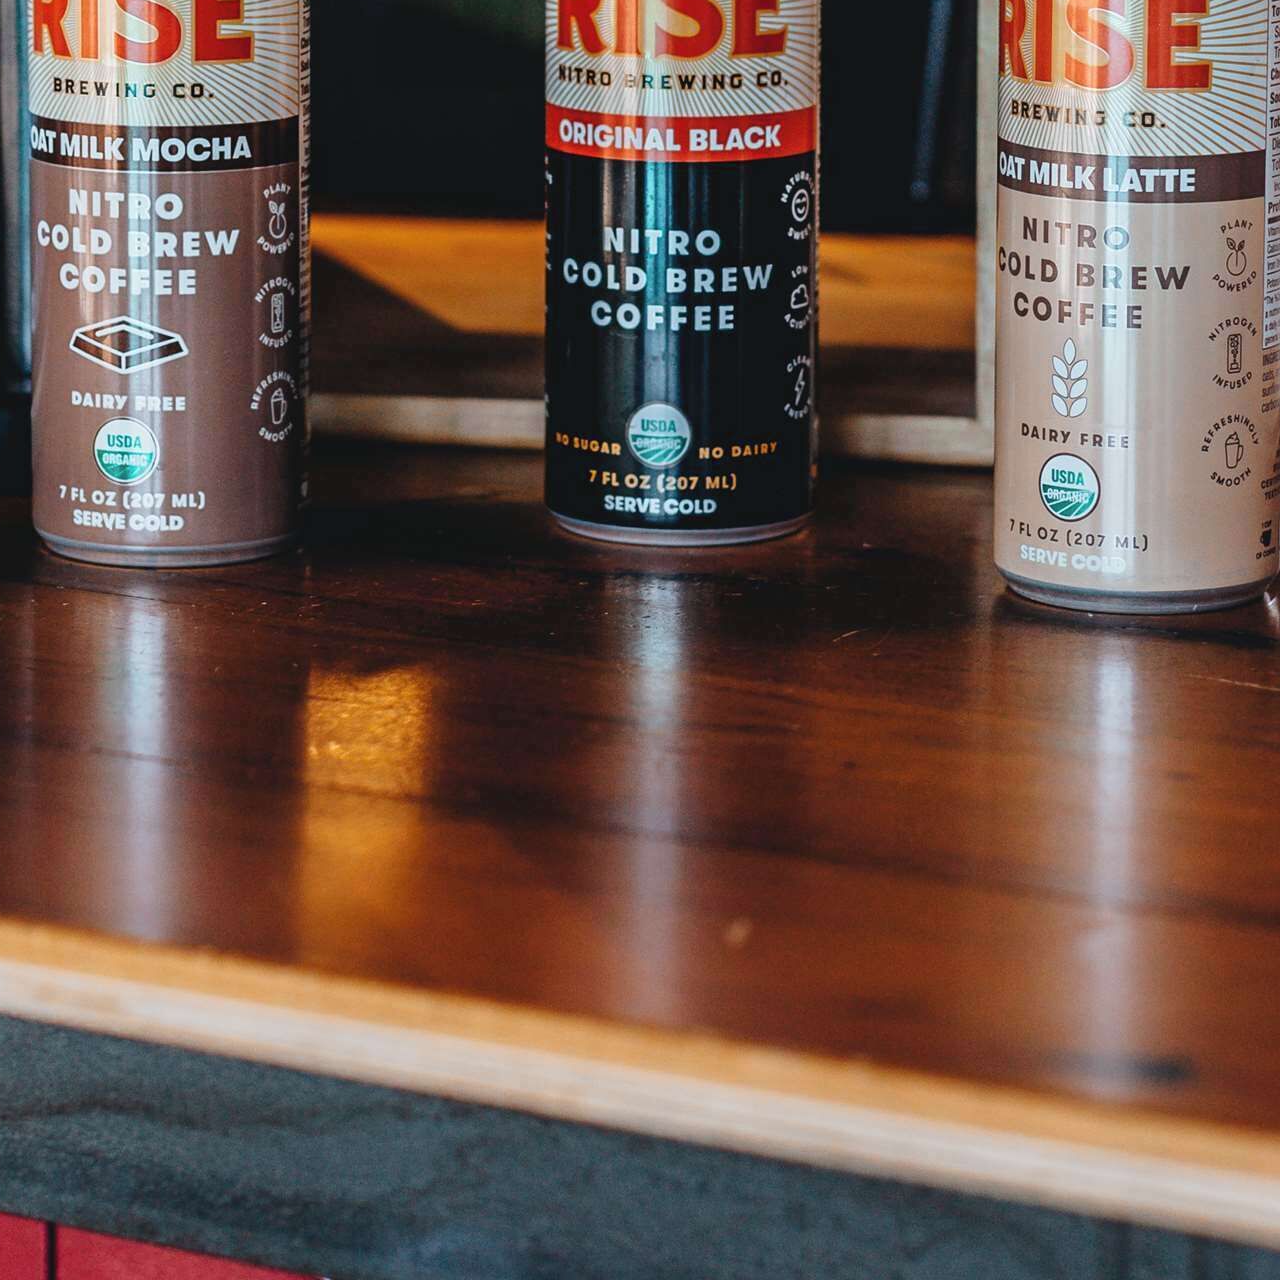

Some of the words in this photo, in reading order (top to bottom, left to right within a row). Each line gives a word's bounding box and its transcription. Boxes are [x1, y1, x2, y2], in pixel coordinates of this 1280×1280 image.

[53, 78, 156, 98] BREWING
[172, 81, 215, 98] CO.
[558, 64, 611, 86] NITRO
[625, 73, 743, 90] BREWING
[756, 71, 788, 87] CO.
[1011, 100, 1105, 126] BREWING
[1124, 111, 1167, 128] CO.
[31, 125, 56, 152] OAT
[60, 132, 123, 160] MILK
[132, 136, 251, 161] MOCHA
[559, 119, 681, 152] ORIGINAL
[689, 124, 781, 152] BLACK
[1000, 151, 1025, 176] OAT
[1030, 161, 1095, 190] MILK
[1103, 167, 1195, 193] LATTE
[264, 182, 291, 198] PLANT
[69, 189, 183, 220] NITRO
[37, 221, 112, 255] COLD
[128, 230, 239, 257] BREW
[1023, 216, 1130, 251] NITRO
[1221, 219, 1254, 234] PLANT
[604, 227, 720, 256] NITRO
[59, 264, 196, 295] COFFEE
[563, 258, 647, 292] COLD
[666, 264, 773, 293] BREW
[999, 246, 1058, 283] COLD
[1076, 264, 1190, 290] BREW
[1212, 271, 1258, 292] POWERED
[591, 300, 735, 331] COFFEE
[1014, 292, 1143, 329] COFFEE
[1209, 316, 1258, 342] NITROGEN
[1212, 371, 1253, 390] INFUSED
[72, 390, 127, 410] DAIRY
[135, 396, 186, 411] FREE
[641, 419, 676, 432] USDA
[1021, 422, 1070, 444] DAIRY
[1080, 431, 1129, 448] FREE
[1201, 414, 1260, 453] REFRESHINGLY
[107, 434, 142, 449] USDA
[555, 432, 569, 447] NO
[573, 435, 621, 455] SUGAR
[699, 445, 721, 459] NO
[732, 442, 777, 457] DAIRY
[102, 451, 148, 466] ORGANIC
[589, 470, 597, 483] 7
[602, 471, 619, 487] FL
[624, 473, 651, 489] OZ
[657, 473, 699, 492] (207
[706, 472, 737, 490] ML)
[1052, 468, 1084, 485] USDA
[1210, 466, 1252, 487] SMOOTH
[59, 486, 66, 500] 7
[71, 488, 87, 505] FL
[91, 491, 117, 507] OZ
[123, 492, 164, 509] (207
[172, 492, 206, 509] ML)
[605, 495, 660, 514] SERVE
[663, 498, 717, 514] COLD
[1047, 488, 1090, 503] ORGANIC
[73, 509, 125, 530] SERVE
[129, 513, 184, 532] COLD
[1010, 518, 1015, 533] 7
[1019, 522, 1032, 537] FL
[1037, 526, 1059, 543] OZ
[1066, 529, 1105, 548] (207
[1115, 535, 1149, 551] ML)
[1019, 544, 1067, 567] SERVE
[1071, 553, 1126, 573] COLD
